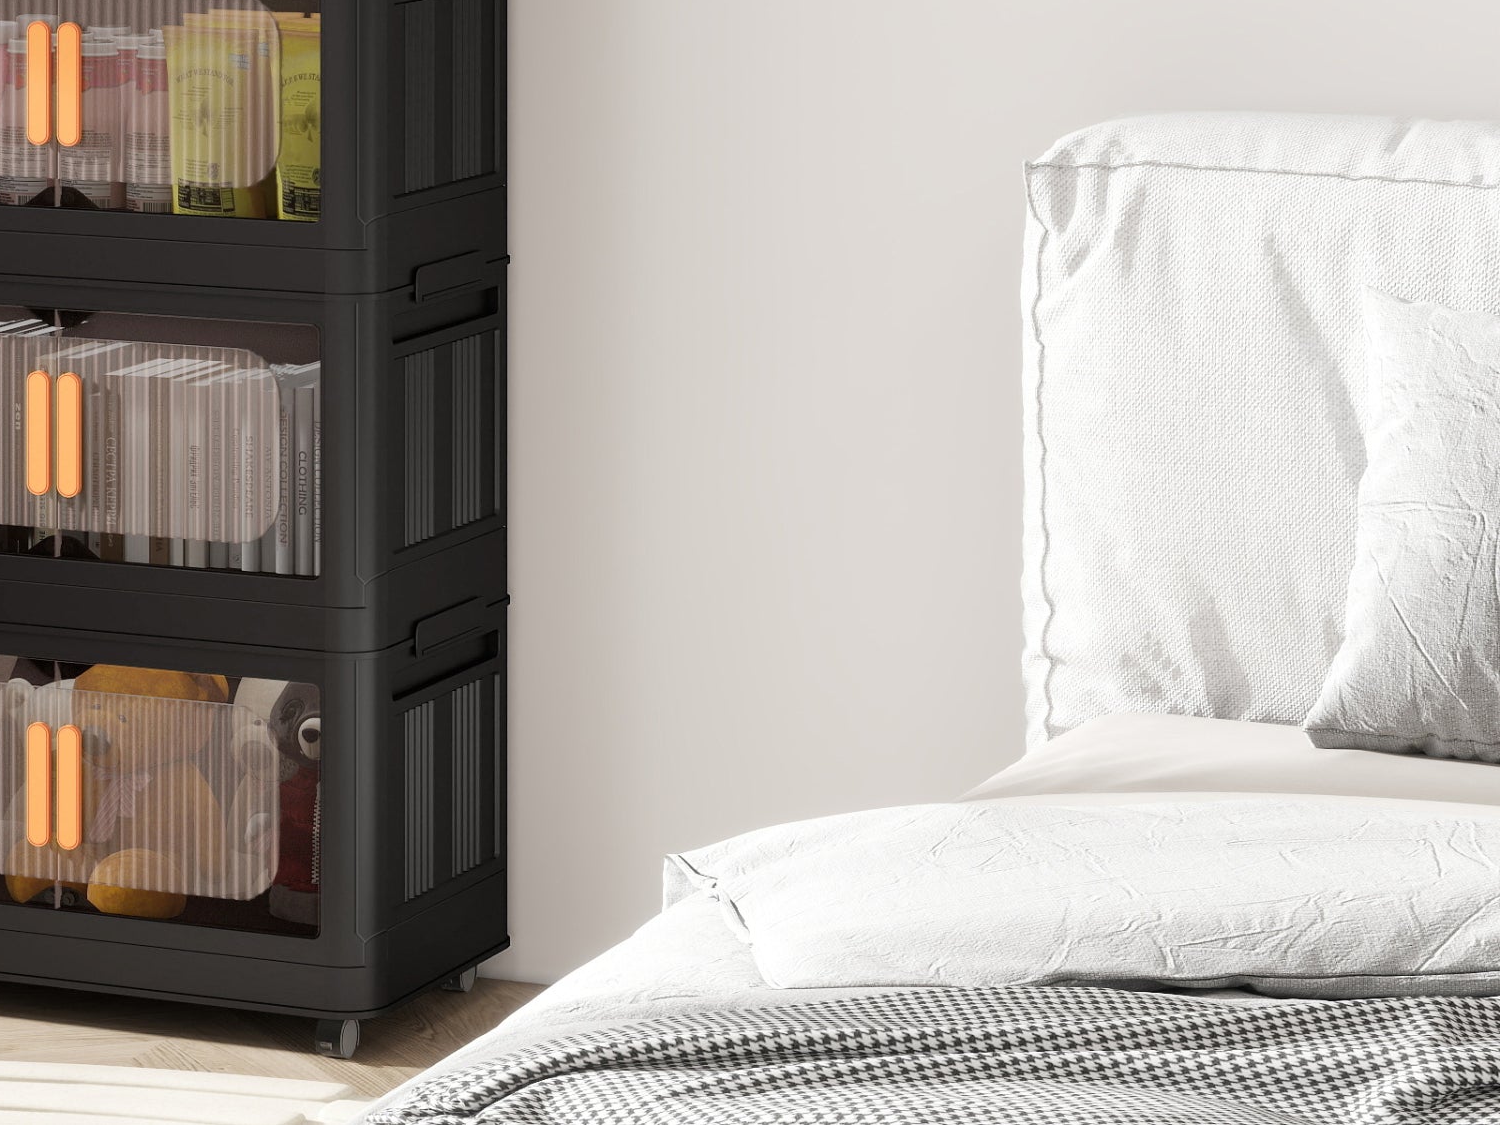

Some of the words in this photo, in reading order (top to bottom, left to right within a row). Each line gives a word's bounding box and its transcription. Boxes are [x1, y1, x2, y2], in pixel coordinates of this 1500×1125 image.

[106, 437, 117, 481] СЕСТРА
[280, 411, 288, 458] DESIGN
[245, 435, 253, 518] SHAKESPEARE
[280, 460, 288, 544] COLLECTION
[298, 451, 307, 516] CLOTHING
